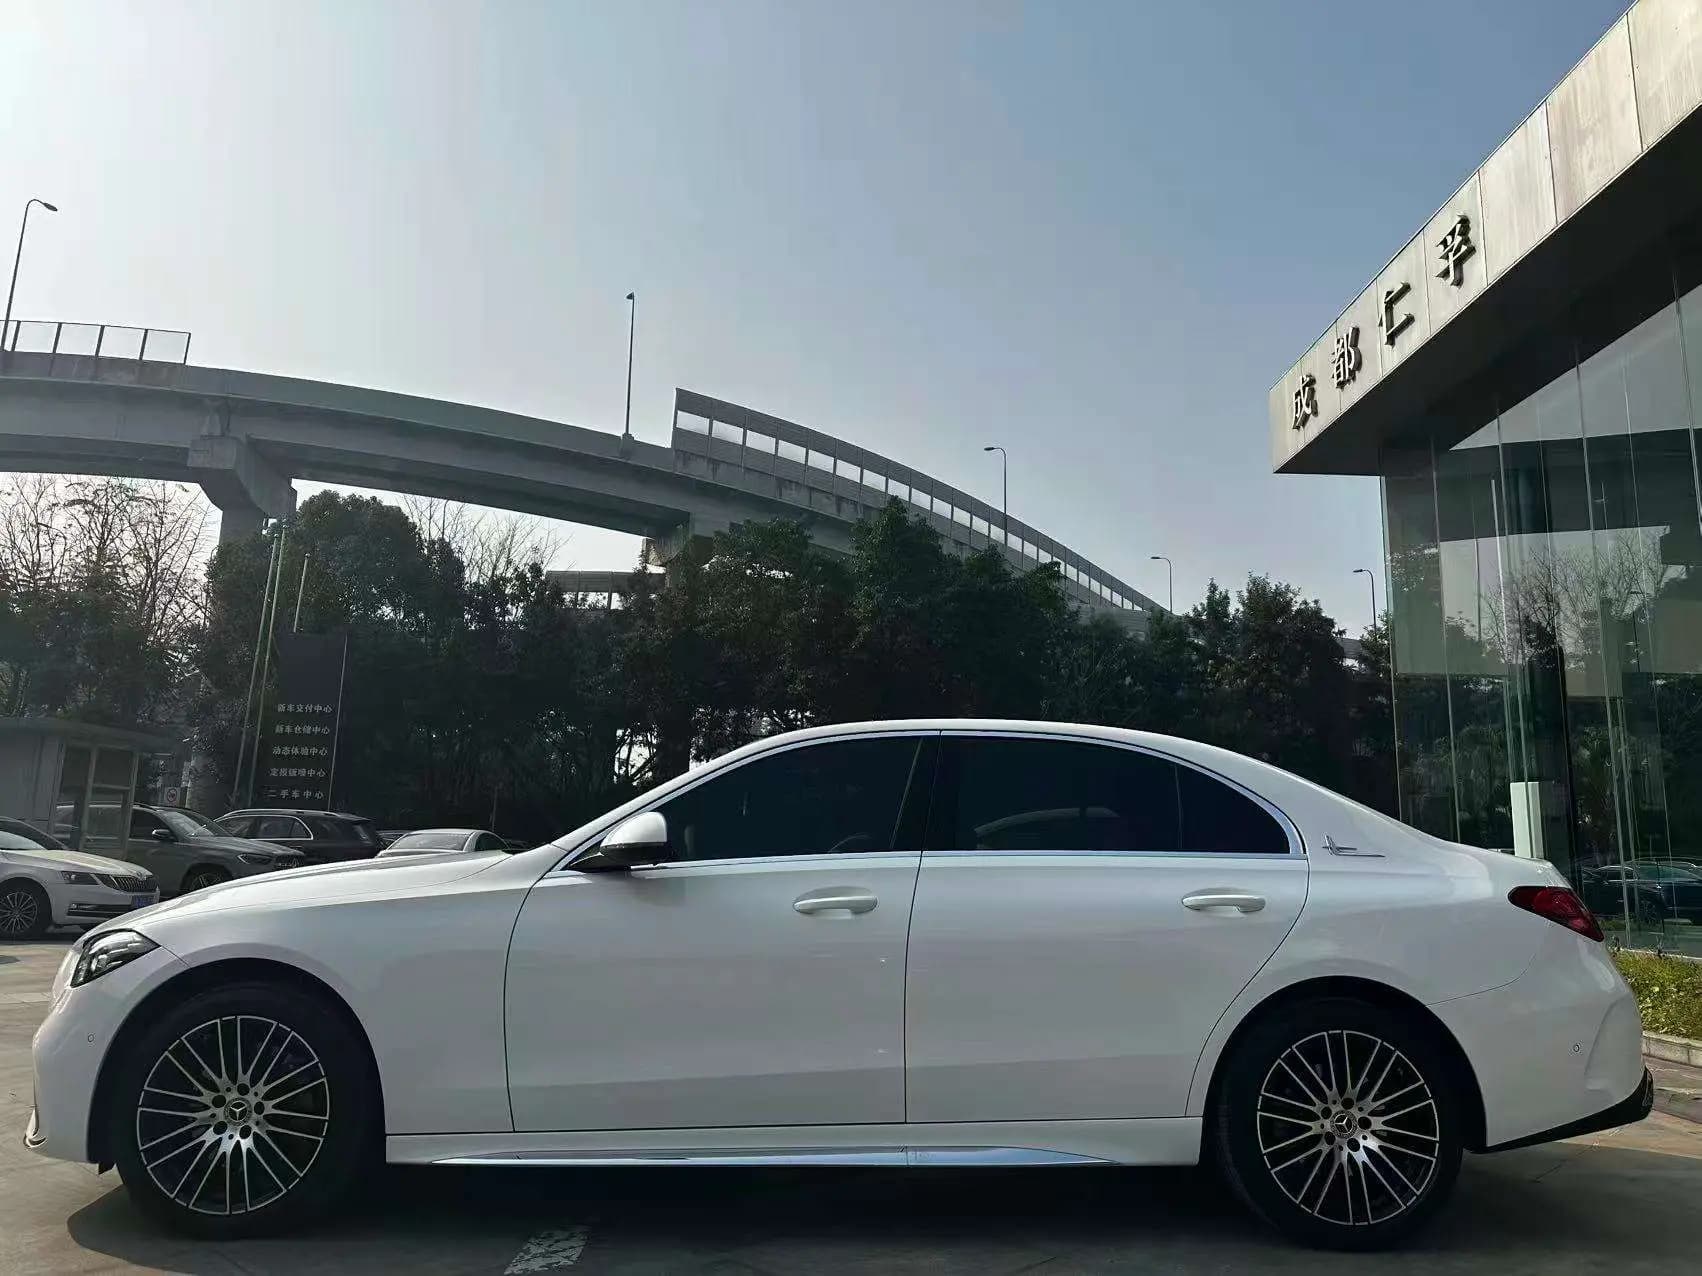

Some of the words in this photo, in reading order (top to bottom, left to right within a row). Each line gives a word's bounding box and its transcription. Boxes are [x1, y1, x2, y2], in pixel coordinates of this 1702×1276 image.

[1291, 213, 1476, 429] 成都仁孚
[267, 789, 324, 799] 二手车中心
